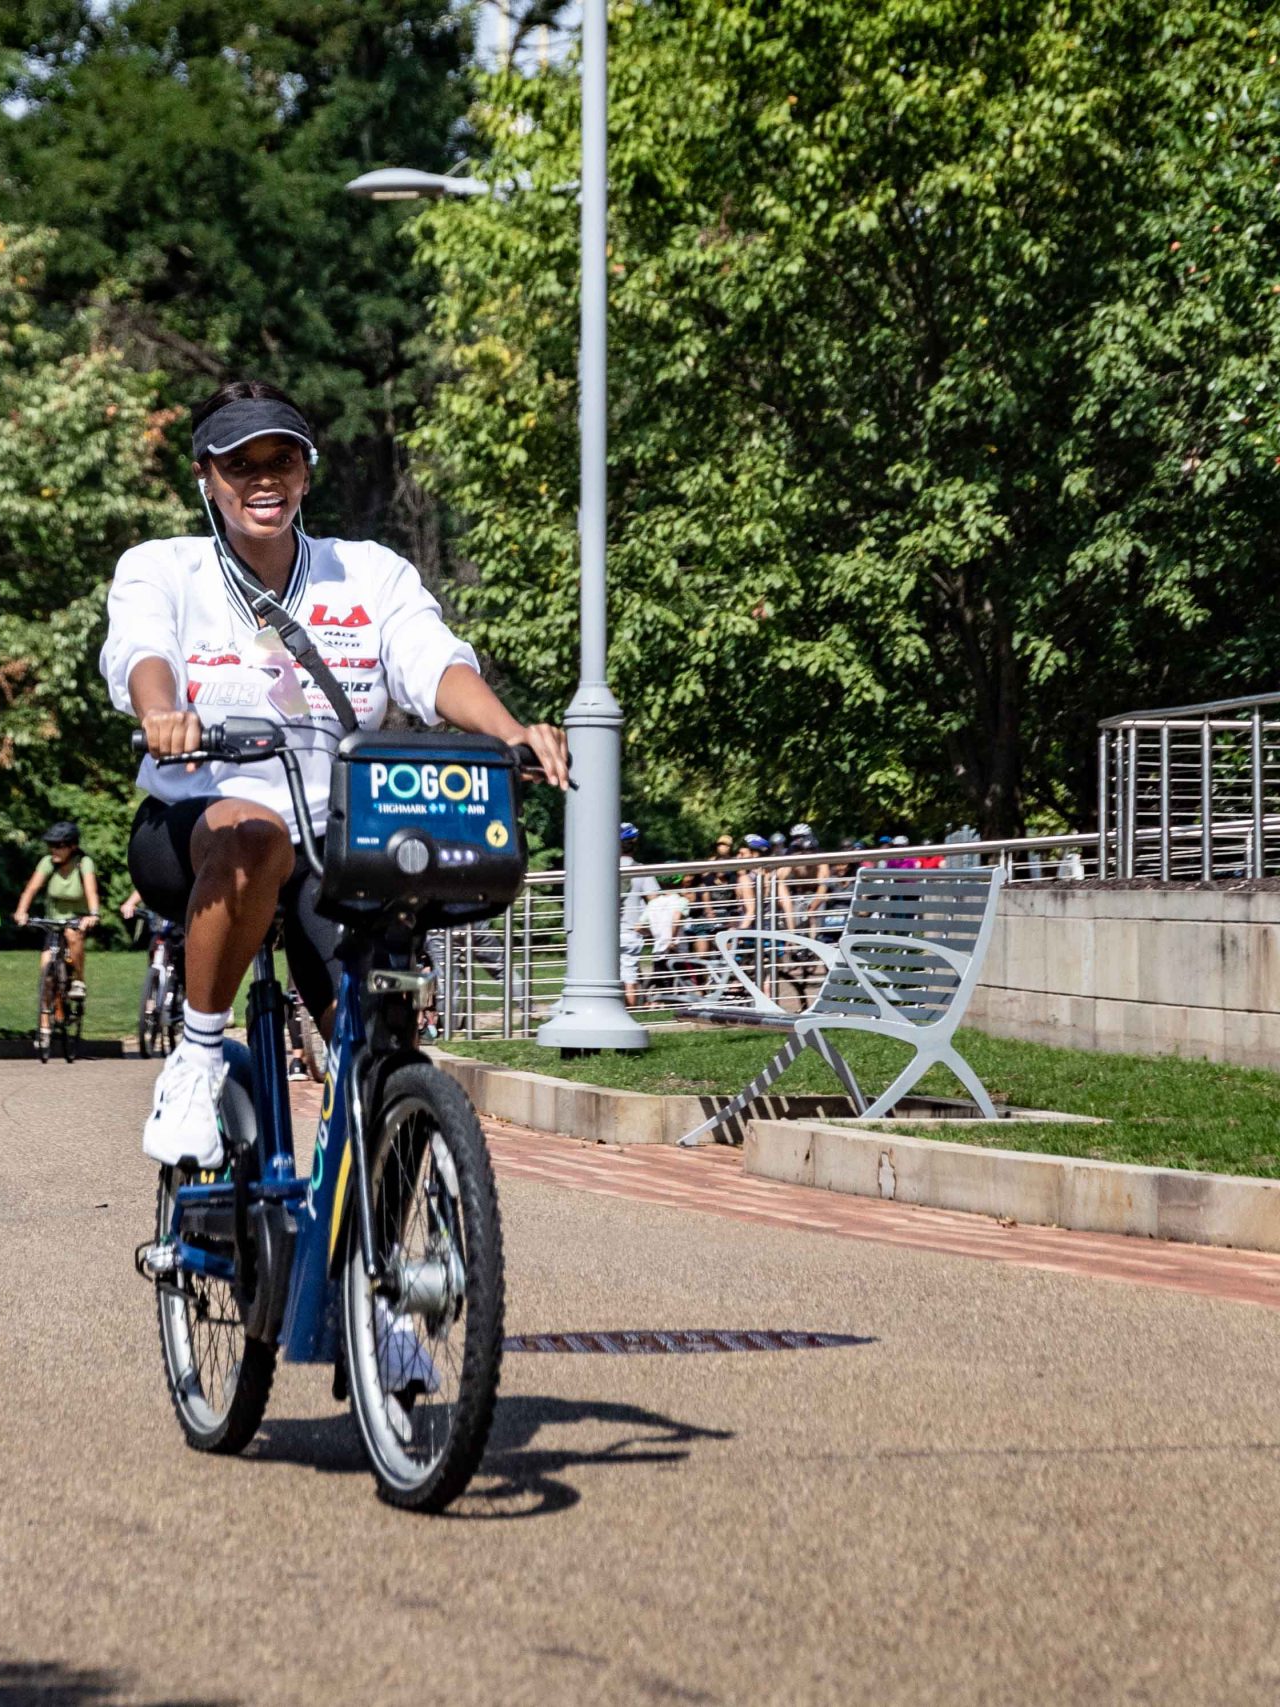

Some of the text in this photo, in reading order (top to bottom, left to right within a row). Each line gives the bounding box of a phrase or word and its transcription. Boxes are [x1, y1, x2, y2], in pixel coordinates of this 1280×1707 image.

[371, 763, 488, 801] POGOH
[377, 803, 486, 815] HIGHMARK AHN
